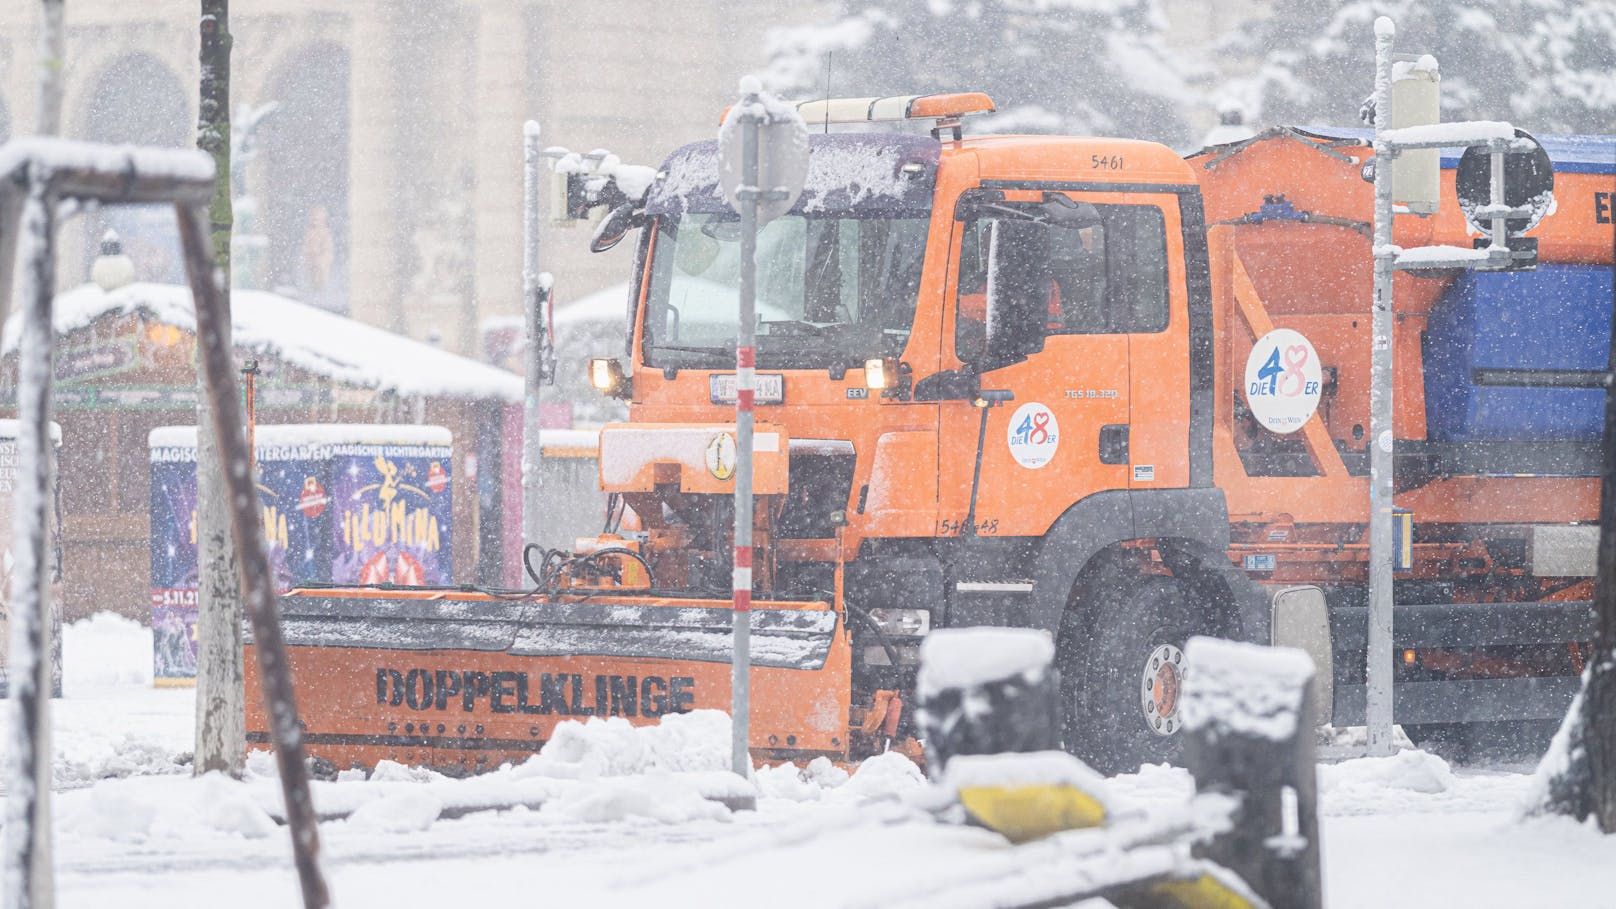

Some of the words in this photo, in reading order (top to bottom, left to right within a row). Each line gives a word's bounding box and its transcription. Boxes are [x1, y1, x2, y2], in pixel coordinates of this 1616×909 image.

[1091, 153, 1124, 170] 5461
[848, 389, 868, 399] EEV
[1065, 389, 1084, 399] TGS
[1250, 382, 1268, 396] DIE
[150, 446, 198, 462] MAGISC
[333, 445, 383, 457] MAGISCHER
[386, 446, 451, 458] LICHTERGARTEN
[375, 668, 695, 719] DOPPELKLINGE
